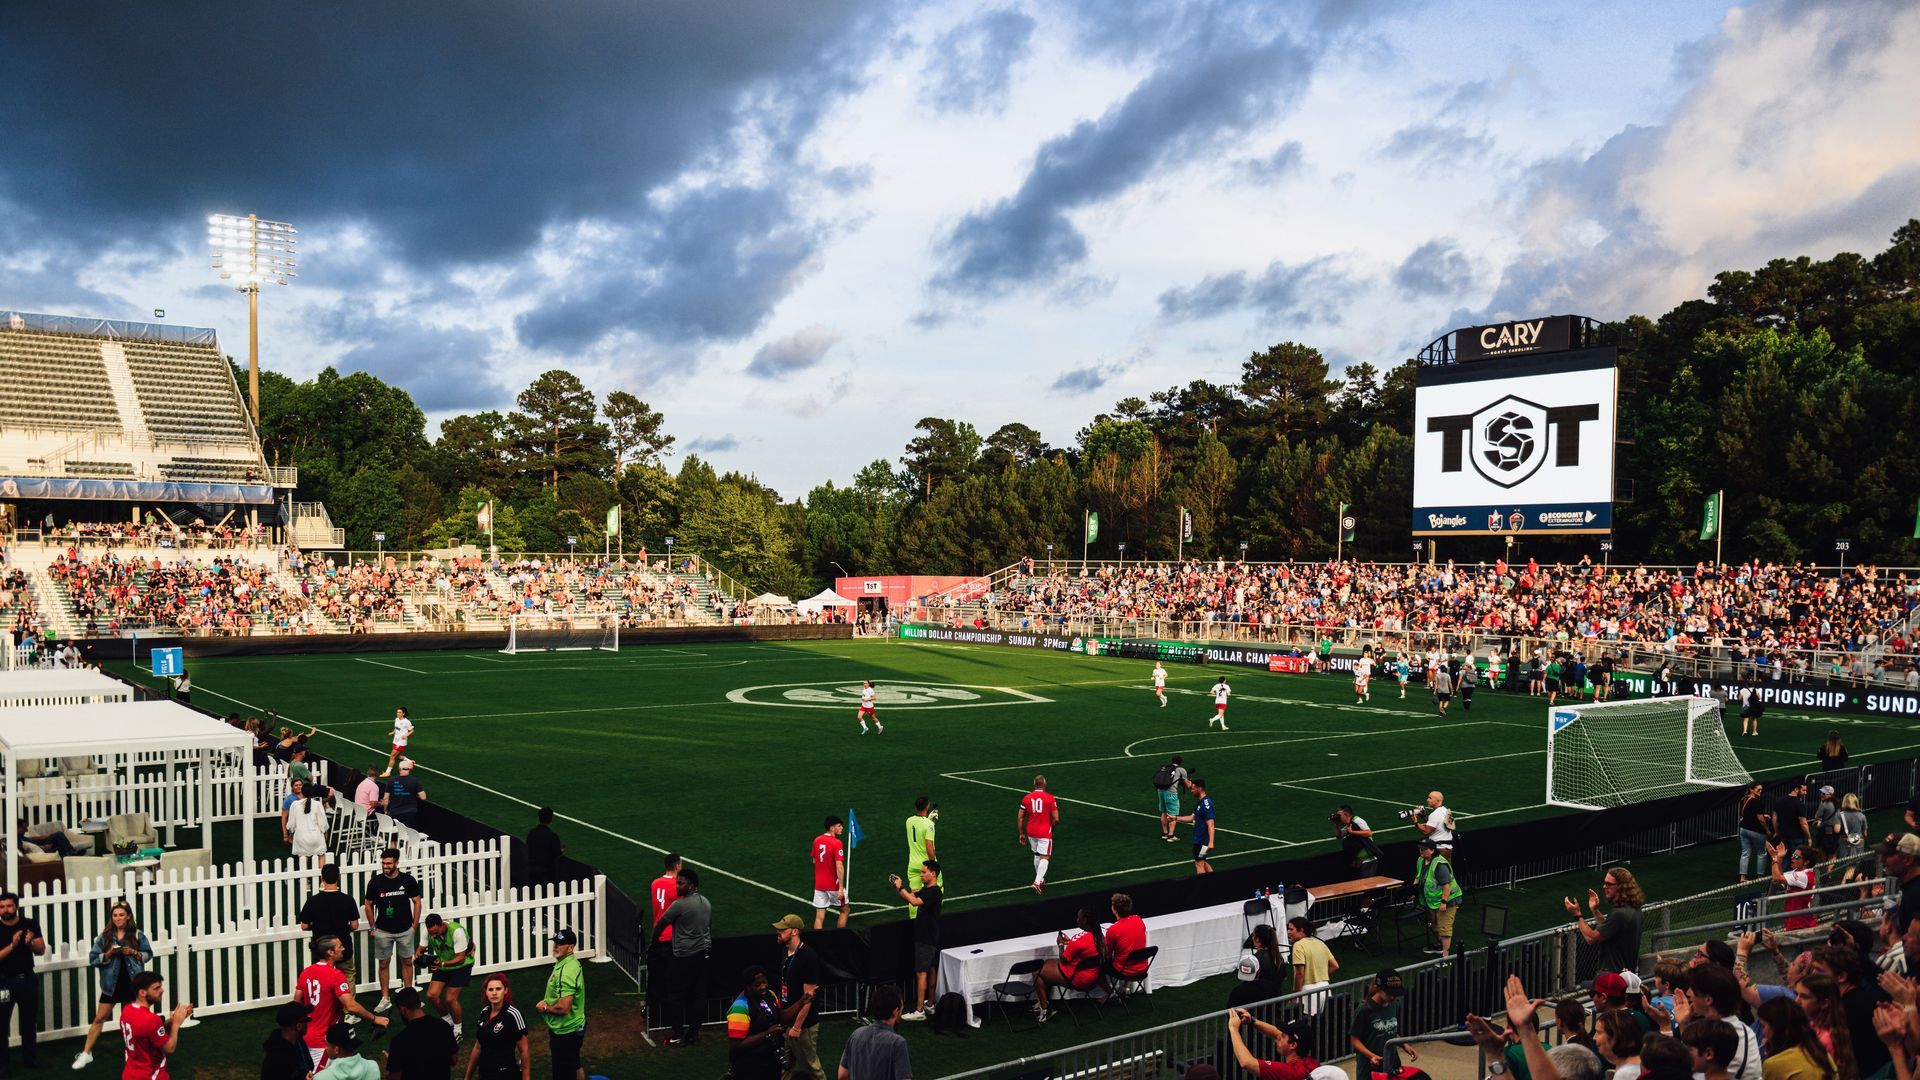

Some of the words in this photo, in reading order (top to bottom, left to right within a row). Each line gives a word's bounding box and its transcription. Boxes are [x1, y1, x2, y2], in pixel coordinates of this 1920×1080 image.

[1480, 320, 1544, 349] CARY
[1427, 400, 1600, 476] TST
[1428, 514, 1467, 529] Bojangles
[1548, 511, 1584, 519] ECONOMY
[1836, 542, 1850, 550] 203
[904, 627, 927, 638] MILLION
[928, 630, 952, 640] DOLLAR
[954, 631, 1002, 644] CHAMPIONSHIP
[1008, 635, 1036, 647] SUNDAY
[166, 653, 174, 673] 1
[1207, 649, 1242, 662] DOLLAR
[1866, 694, 1920, 714] SUND
[1030, 797, 1043, 813] 10
[912, 825, 917, 842] 1
[819, 843, 827, 862] 7
[656, 887, 666, 910] 4
[306, 978, 321, 1006] 13
[121, 1020, 135, 1051] 12
